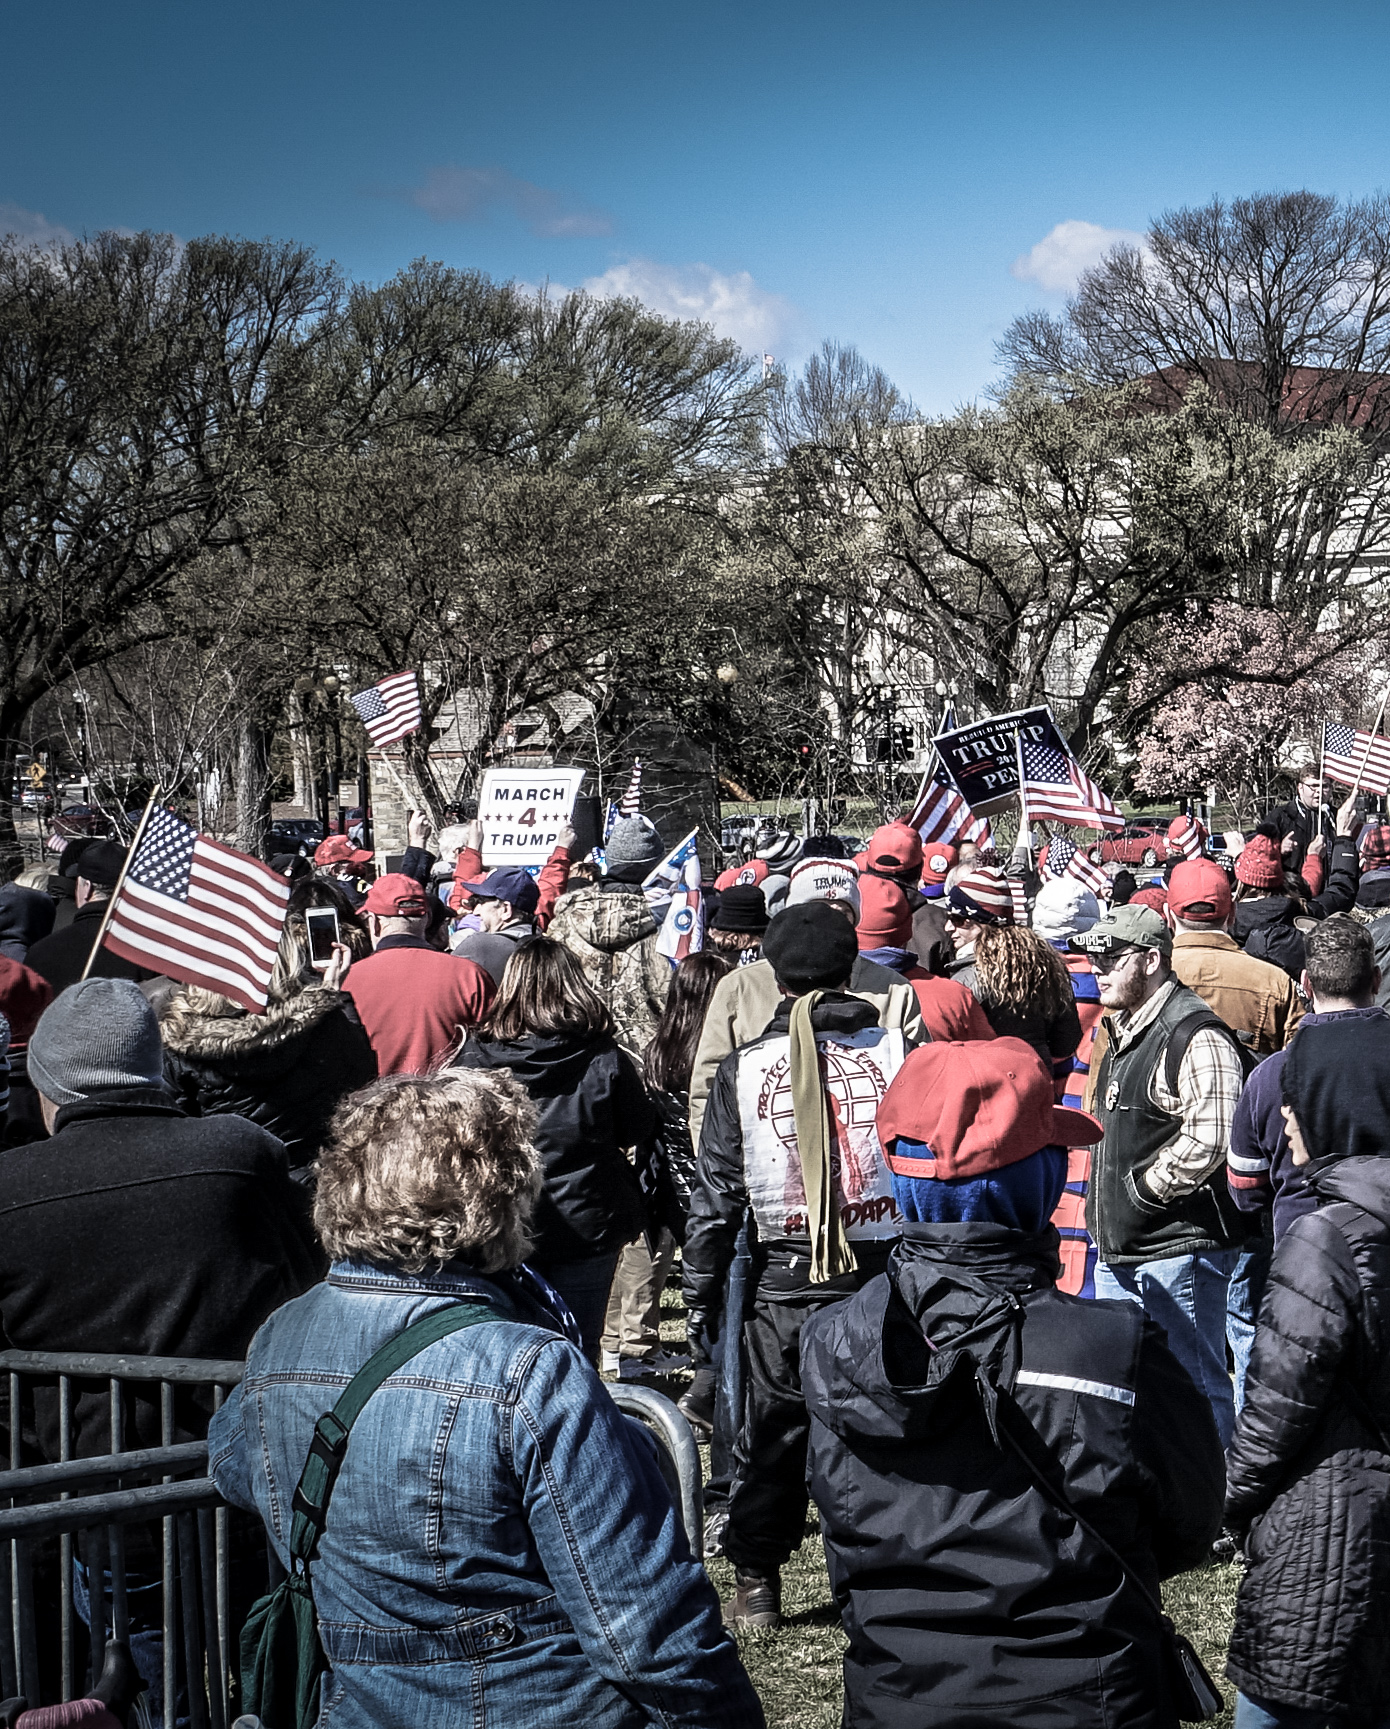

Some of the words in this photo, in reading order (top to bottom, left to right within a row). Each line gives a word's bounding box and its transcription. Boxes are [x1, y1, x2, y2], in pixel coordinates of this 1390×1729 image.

[959, 726, 994, 744] REBUILD
[995, 718, 1029, 732] AMERICA
[982, 766, 1019, 790] PEN
[494, 787, 565, 801] MARCH
[517, 807, 536, 828] 4
[490, 833, 557, 846] TRUMP
